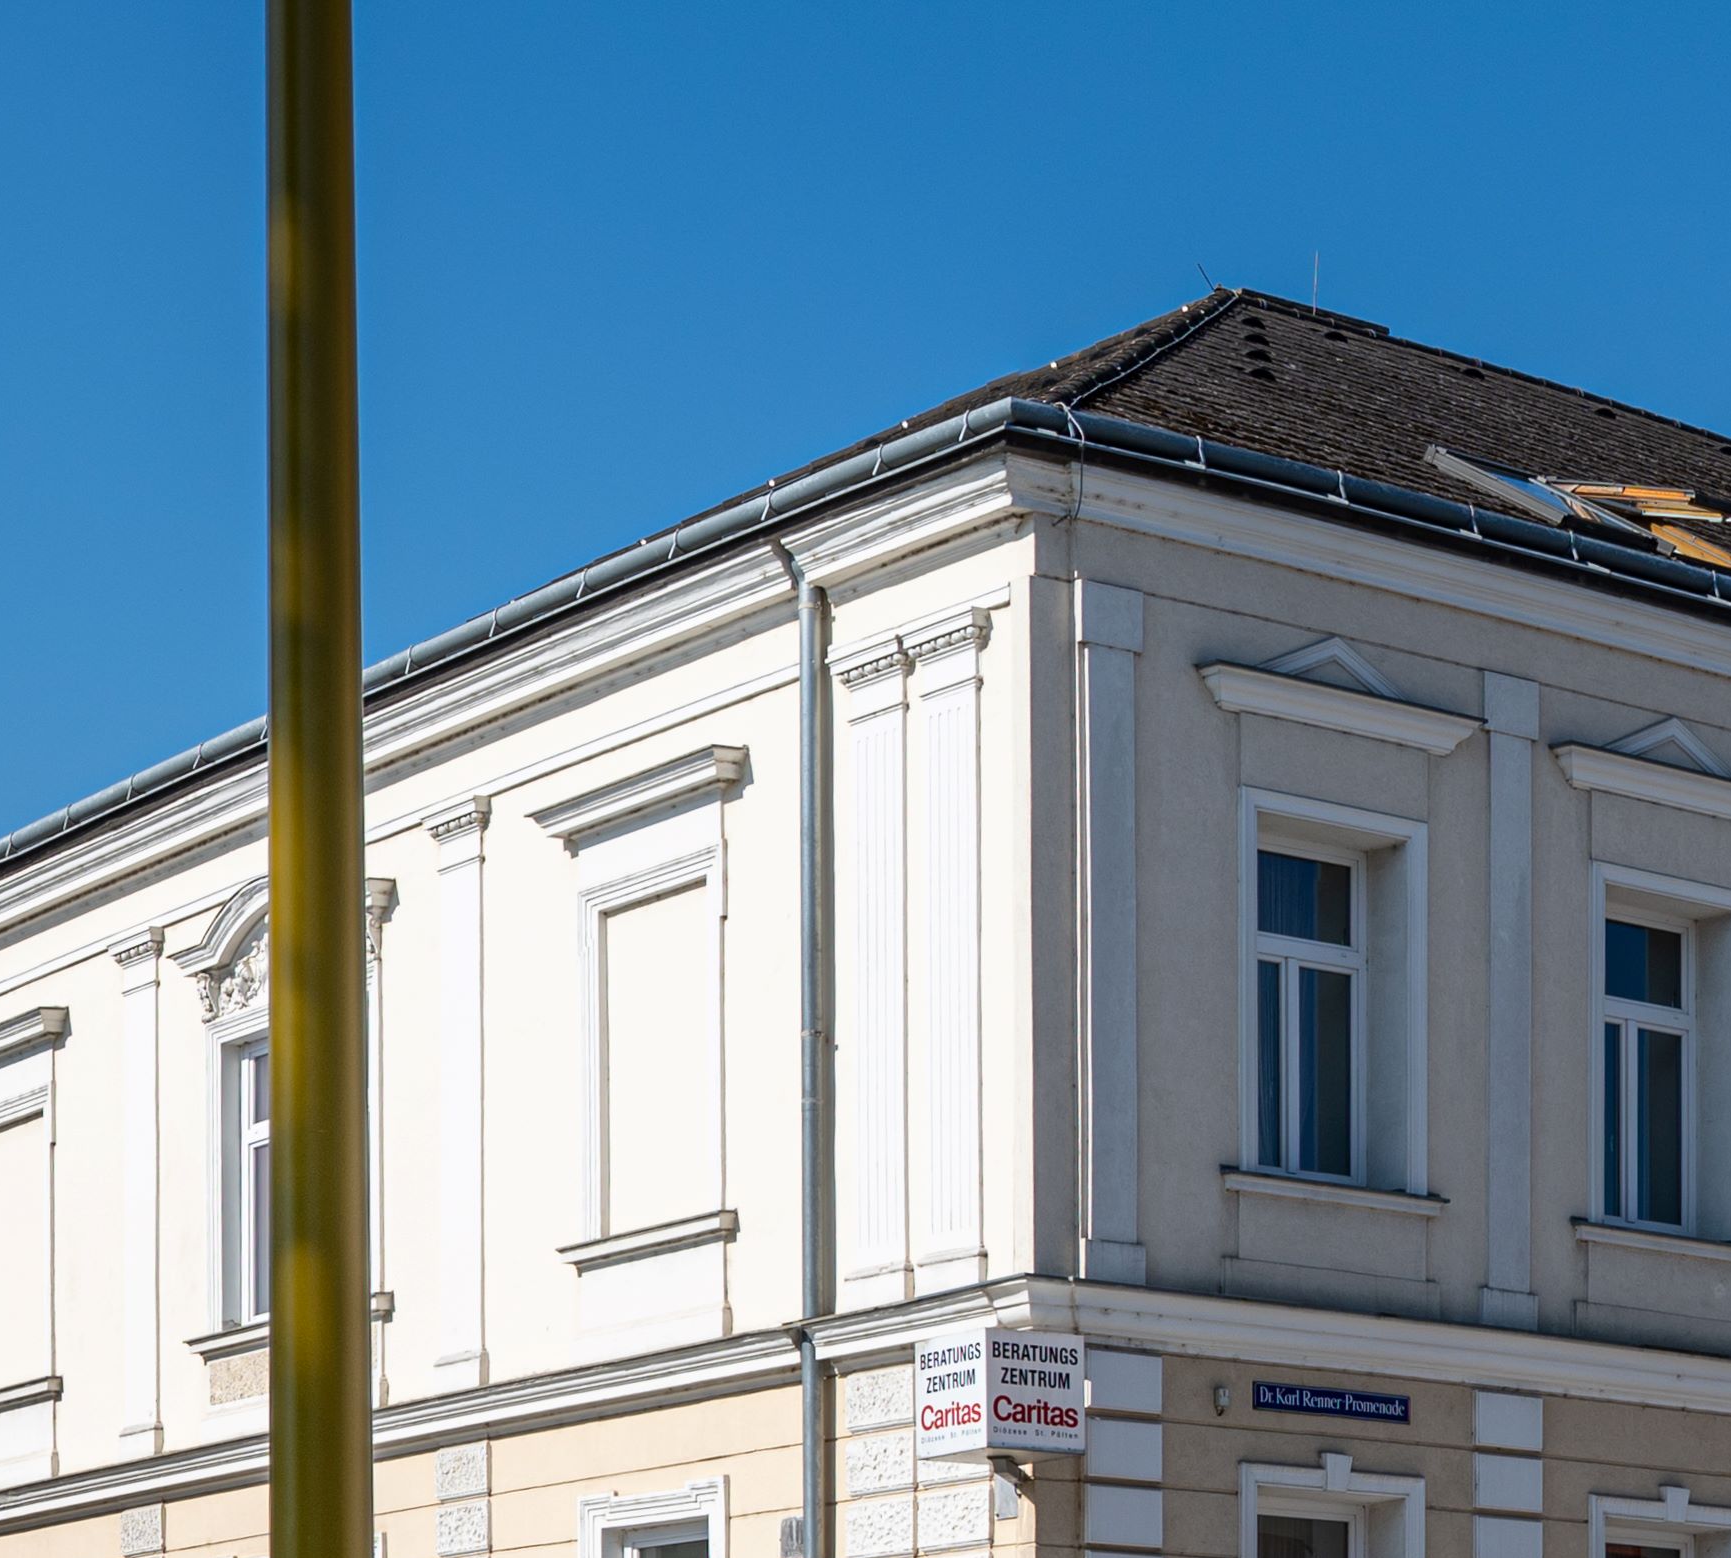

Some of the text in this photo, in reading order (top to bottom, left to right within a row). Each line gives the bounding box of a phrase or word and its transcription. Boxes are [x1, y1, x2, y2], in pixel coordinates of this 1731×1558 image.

[920, 1342, 982, 1371] BERATUNGS
[992, 1340, 1079, 1366] BERATUNGS
[926, 1368, 976, 1394] ZENTRUM
[1001, 1367, 1071, 1390] ZENTRUM
[993, 1394, 1079, 1428] Caritas
[1259, 1386, 1274, 1404] Dr.
[1276, 1387, 1300, 1406] Karl
[1345, 1394, 1406, 1416] Promenade
[921, 1401, 982, 1431] Caritas
[993, 1426, 1028, 1436] Diözese
[1051, 1430, 1079, 1440] Pölten
